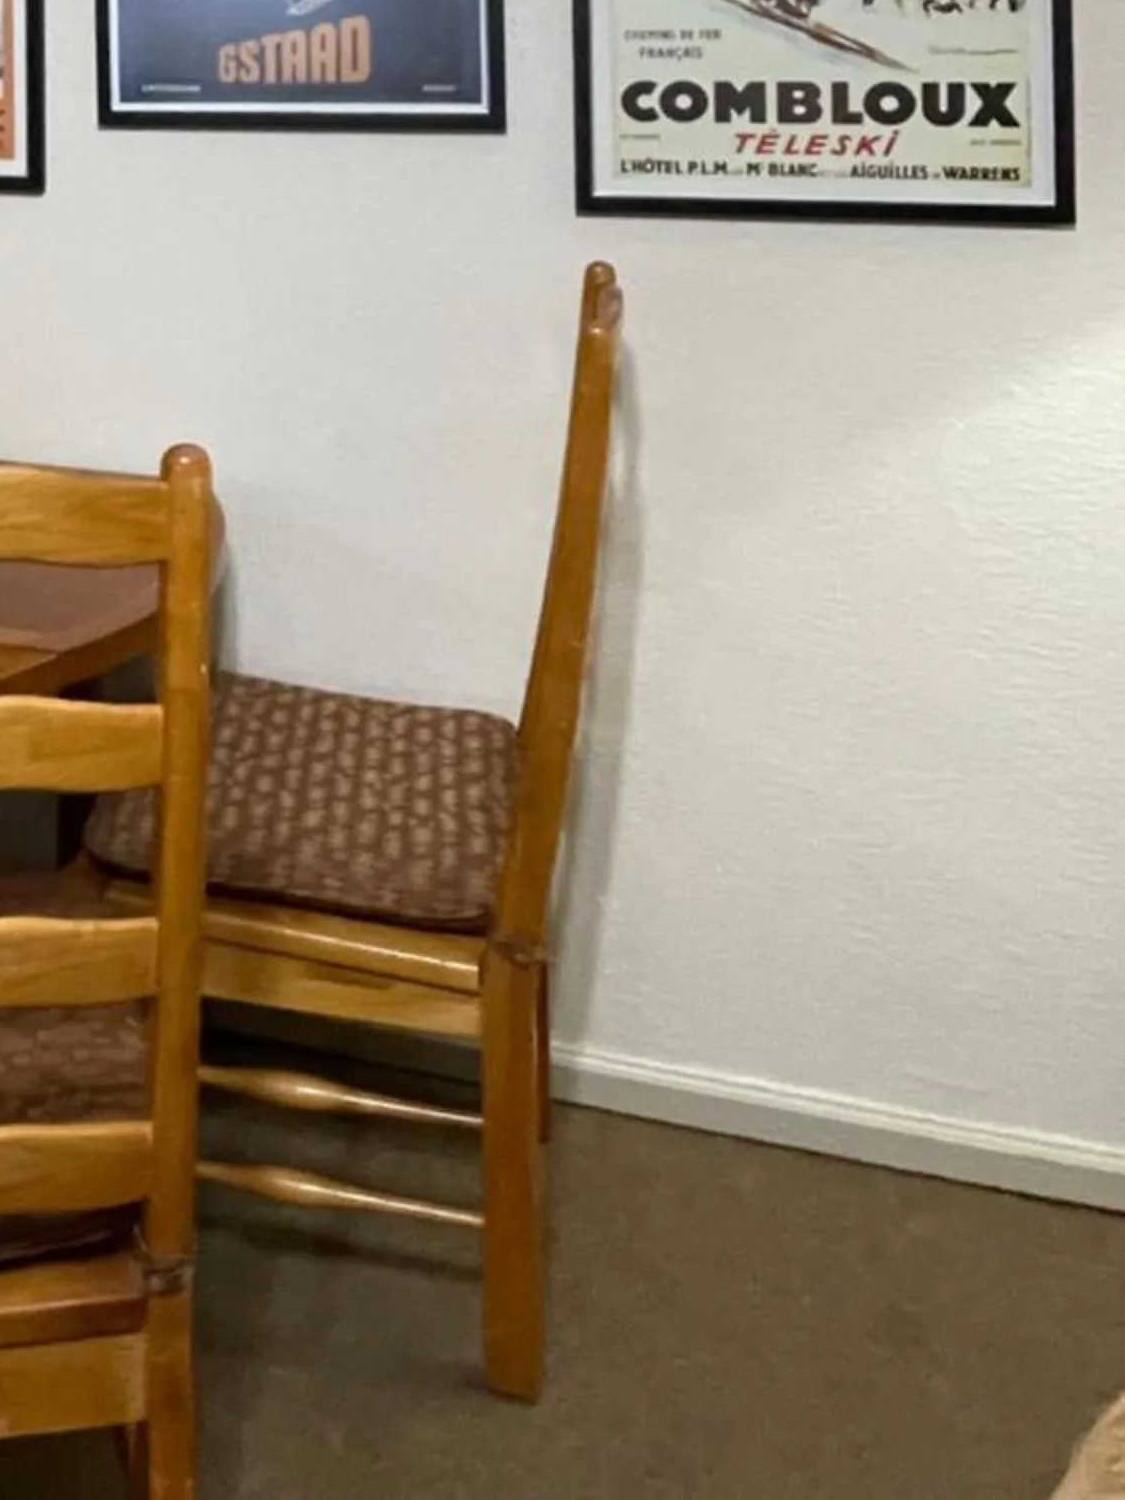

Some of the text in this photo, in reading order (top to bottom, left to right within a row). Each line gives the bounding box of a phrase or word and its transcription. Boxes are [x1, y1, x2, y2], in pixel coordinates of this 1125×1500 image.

[219, 14, 371, 84] GSTAAD
[620, 80, 1021, 129] COMBLOUX
[768, 162, 819, 178] BLANC
